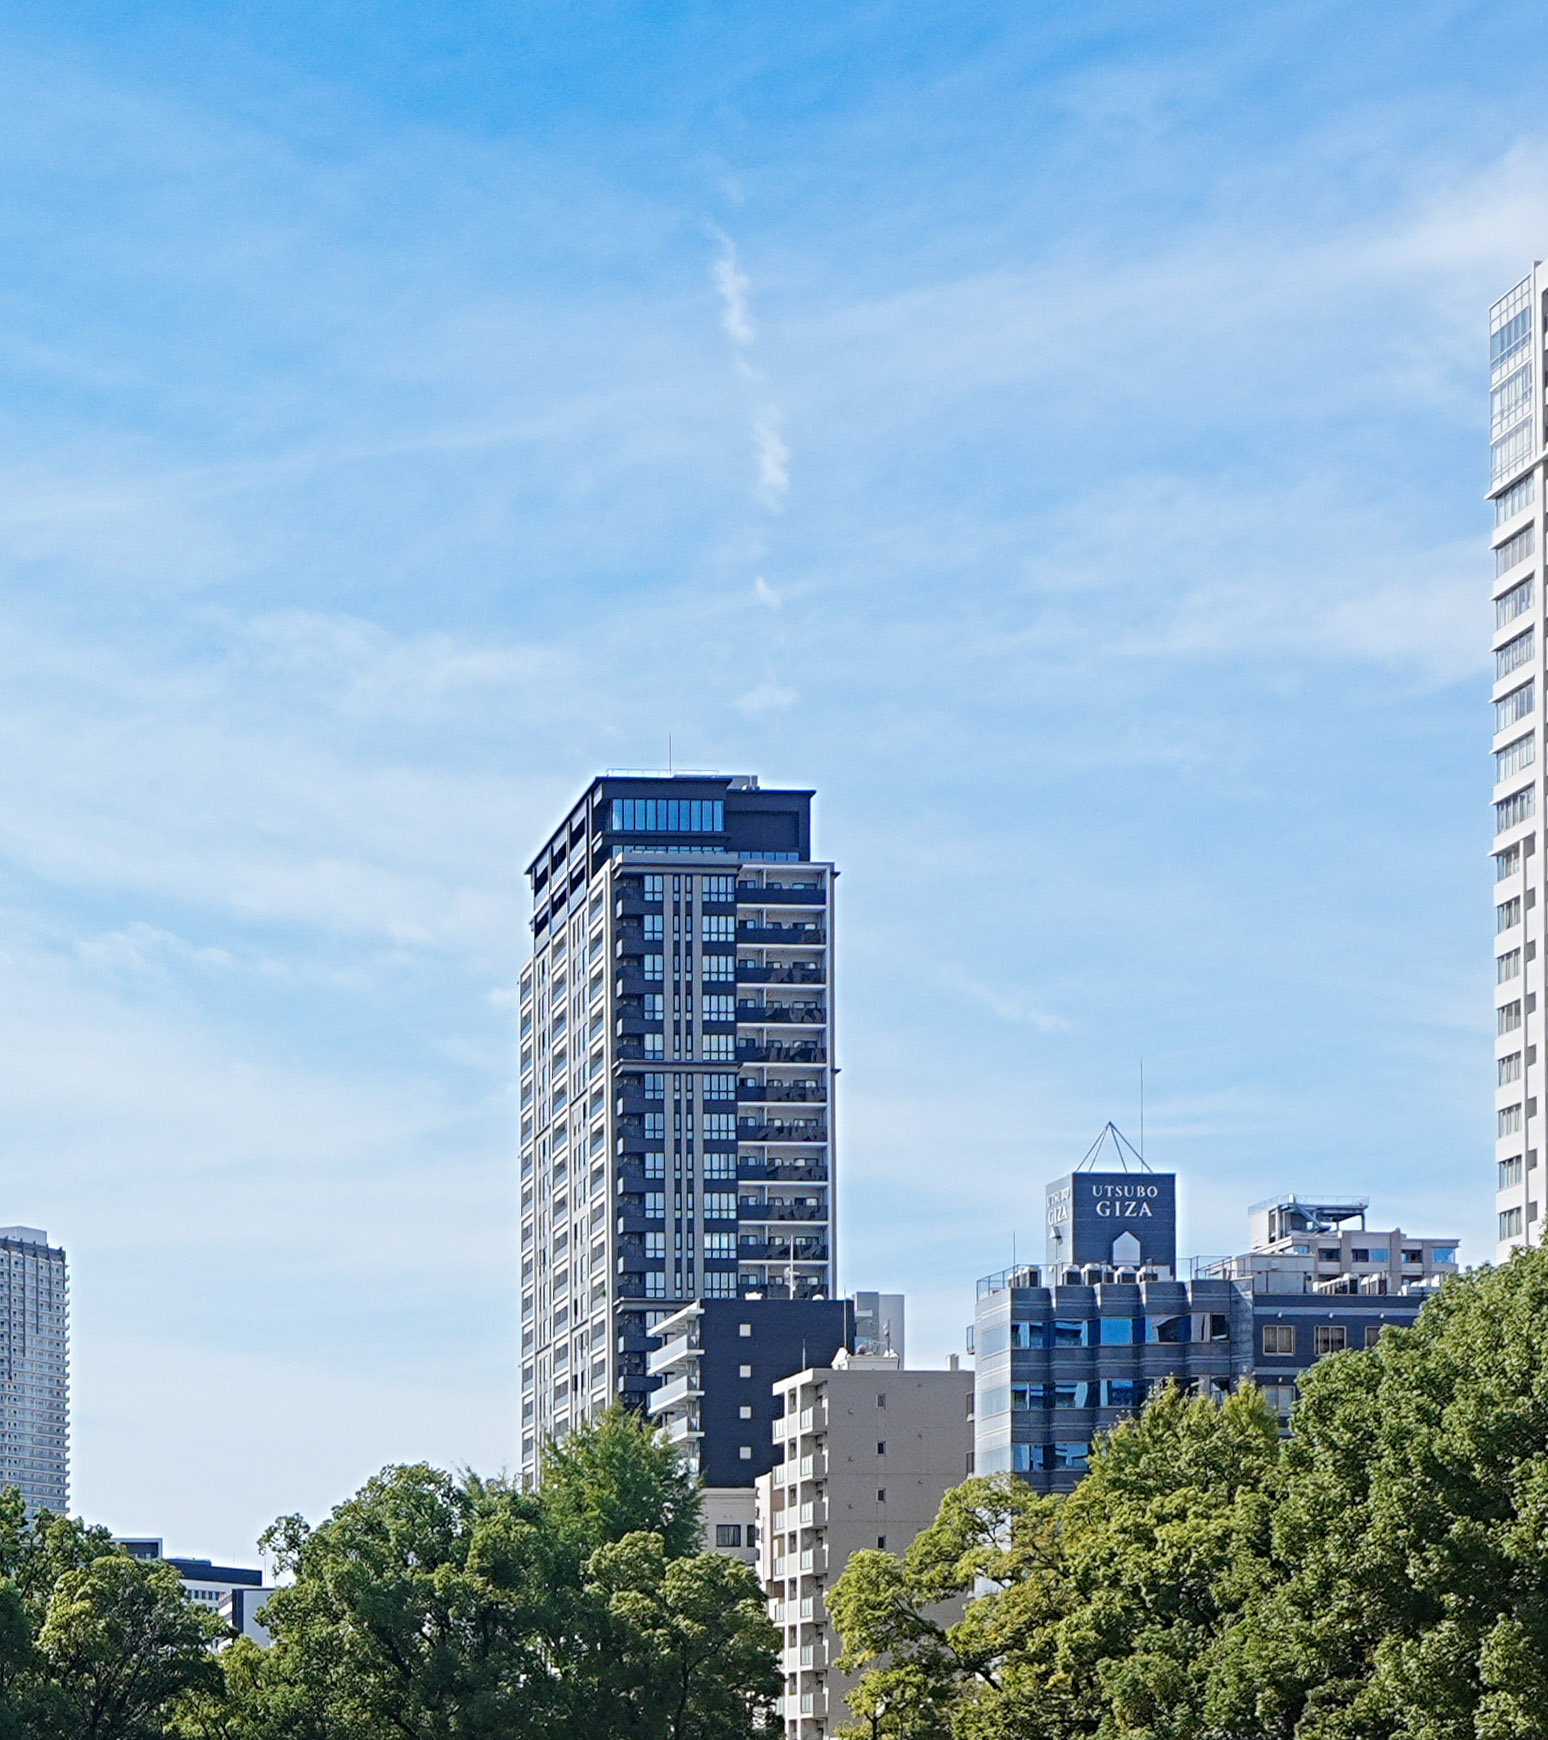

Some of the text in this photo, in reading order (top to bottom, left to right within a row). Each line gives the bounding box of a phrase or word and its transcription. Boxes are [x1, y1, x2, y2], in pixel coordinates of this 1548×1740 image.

[1092, 1185, 1158, 1198] UTSUBO
[1047, 1205, 1068, 1226] GIZA
[1095, 1200, 1153, 1217] GIZA
